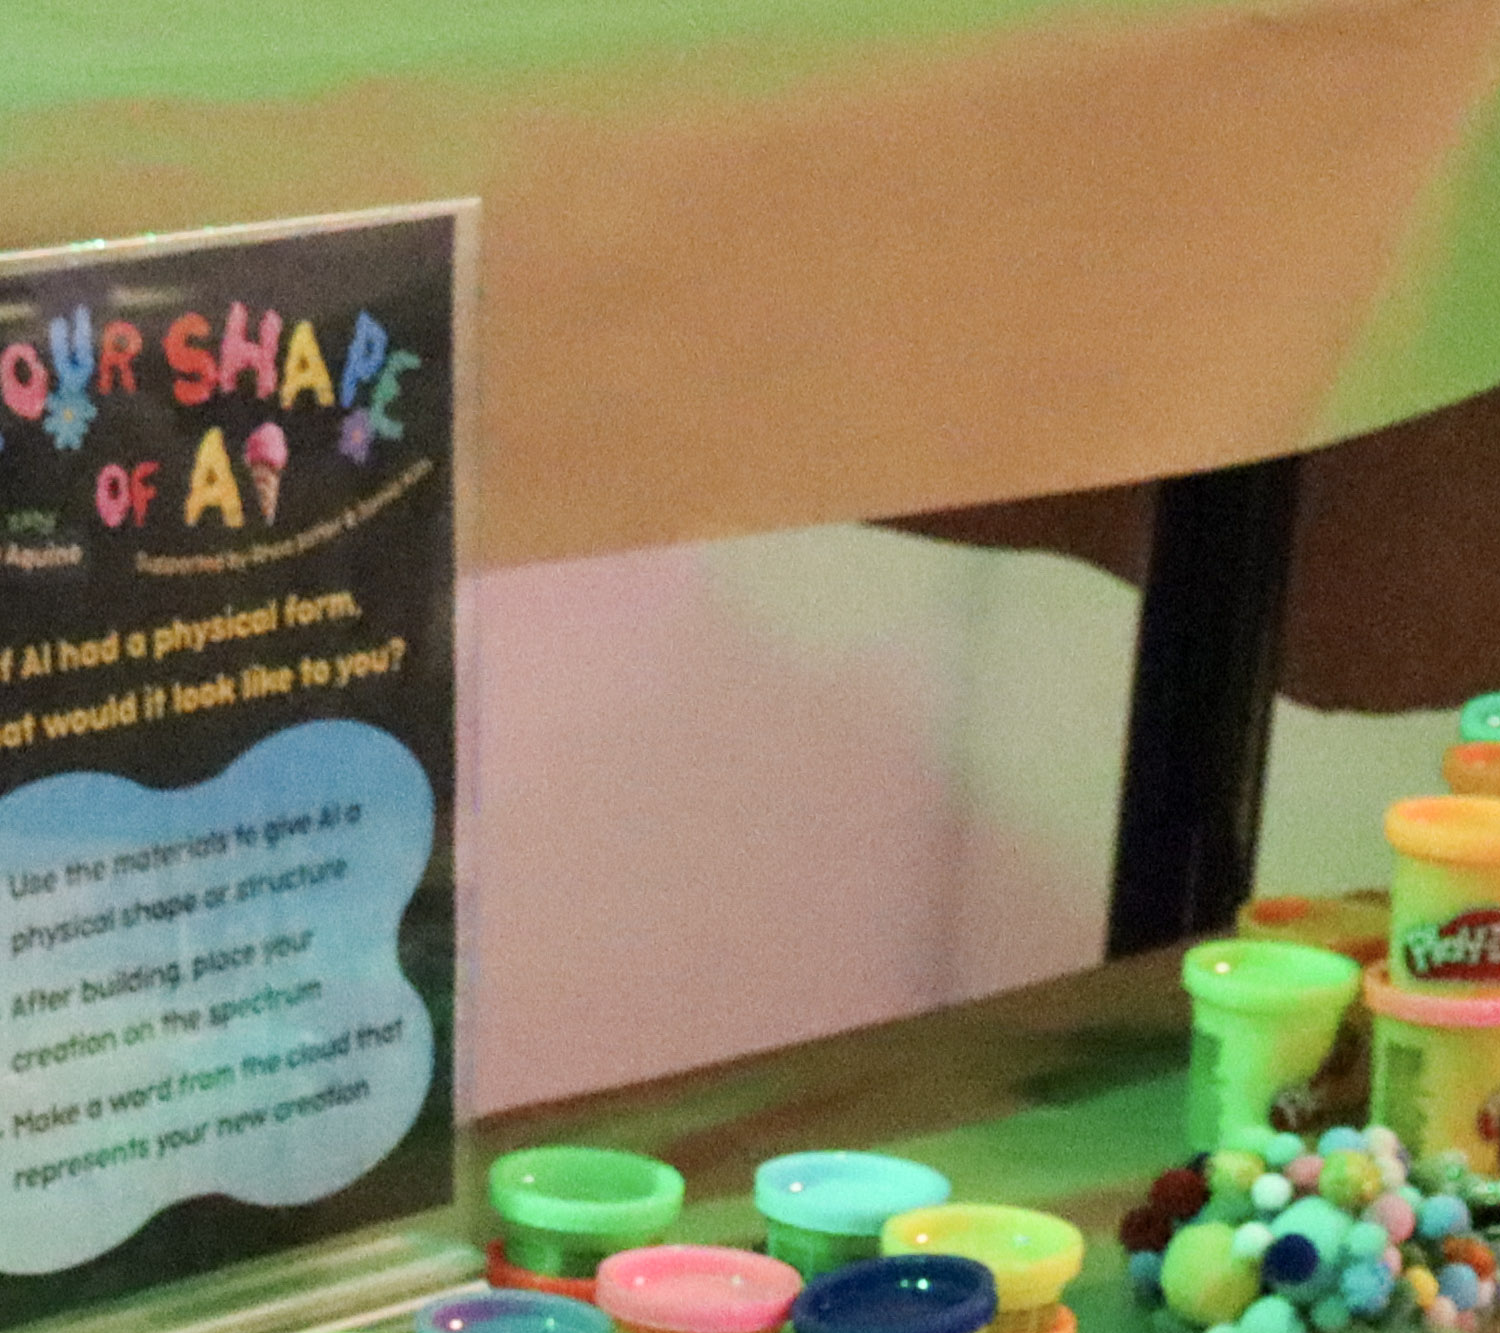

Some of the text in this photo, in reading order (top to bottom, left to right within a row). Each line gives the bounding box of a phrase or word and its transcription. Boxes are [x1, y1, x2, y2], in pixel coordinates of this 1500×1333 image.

[163, 301, 421, 440] SHAPE
[95, 461, 160, 527] OF
[20, 643, 52, 679] AI
[58, 630, 120, 670] had
[125, 633, 148, 659] a
[153, 600, 278, 660] physical
[42, 693, 138, 740] would
[145, 686, 168, 721] it
[173, 673, 236, 713] look
[241, 664, 297, 700] like
[301, 657, 331, 688] to
[336, 636, 407, 688] you?
[9, 802, 363, 900] Use the materials to give AI a
[10, 857, 348, 957] physical shape or structure
[11, 986, 73, 1019] After
[192, 943, 257, 982] place
[261, 927, 315, 965] your
[11, 979, 322, 1074] creation on the spectrum
[12, 1018, 403, 1138] Make a word from the cloud that
[12, 1077, 371, 1190] represents your new creation
